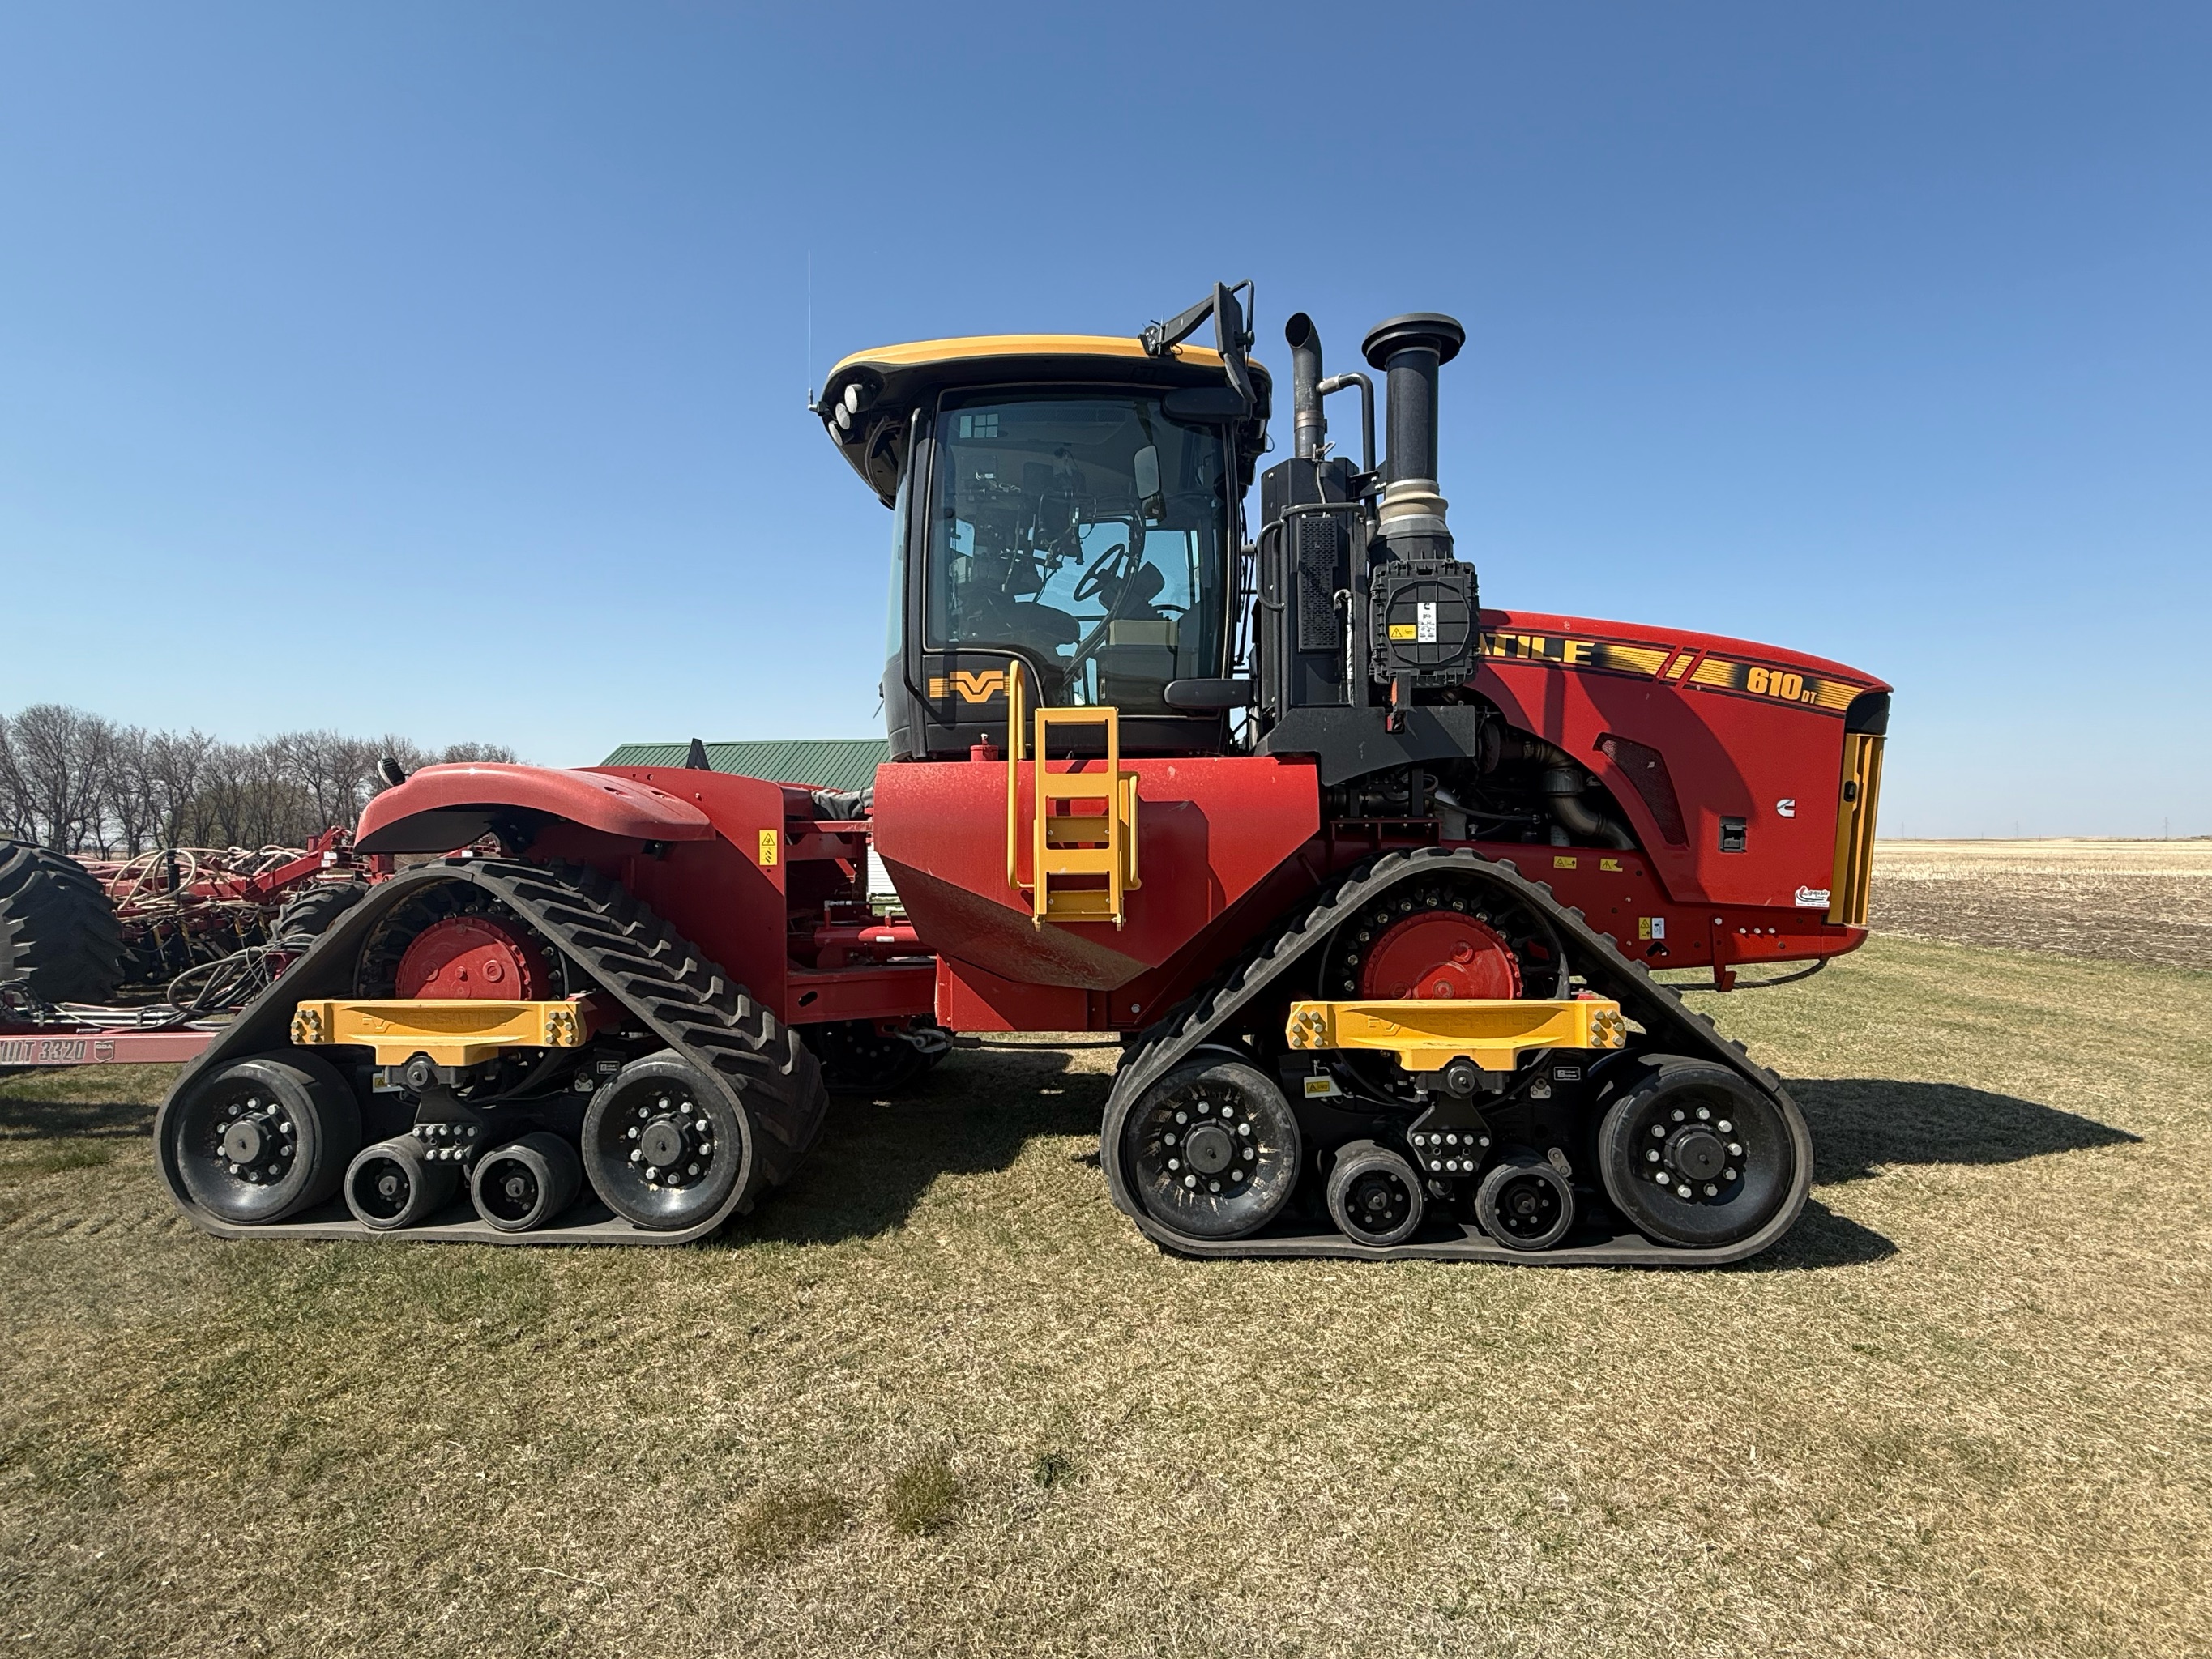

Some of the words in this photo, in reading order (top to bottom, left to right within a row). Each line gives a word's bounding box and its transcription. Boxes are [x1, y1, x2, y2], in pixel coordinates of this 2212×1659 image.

[1747, 667, 1803, 701] 610
[1800, 689, 1817, 704] DT
[1408, 1012, 1538, 1029] VERSATILE
[0, 1040, 35, 1063] ULT
[38, 1040, 87, 1061] 3320
